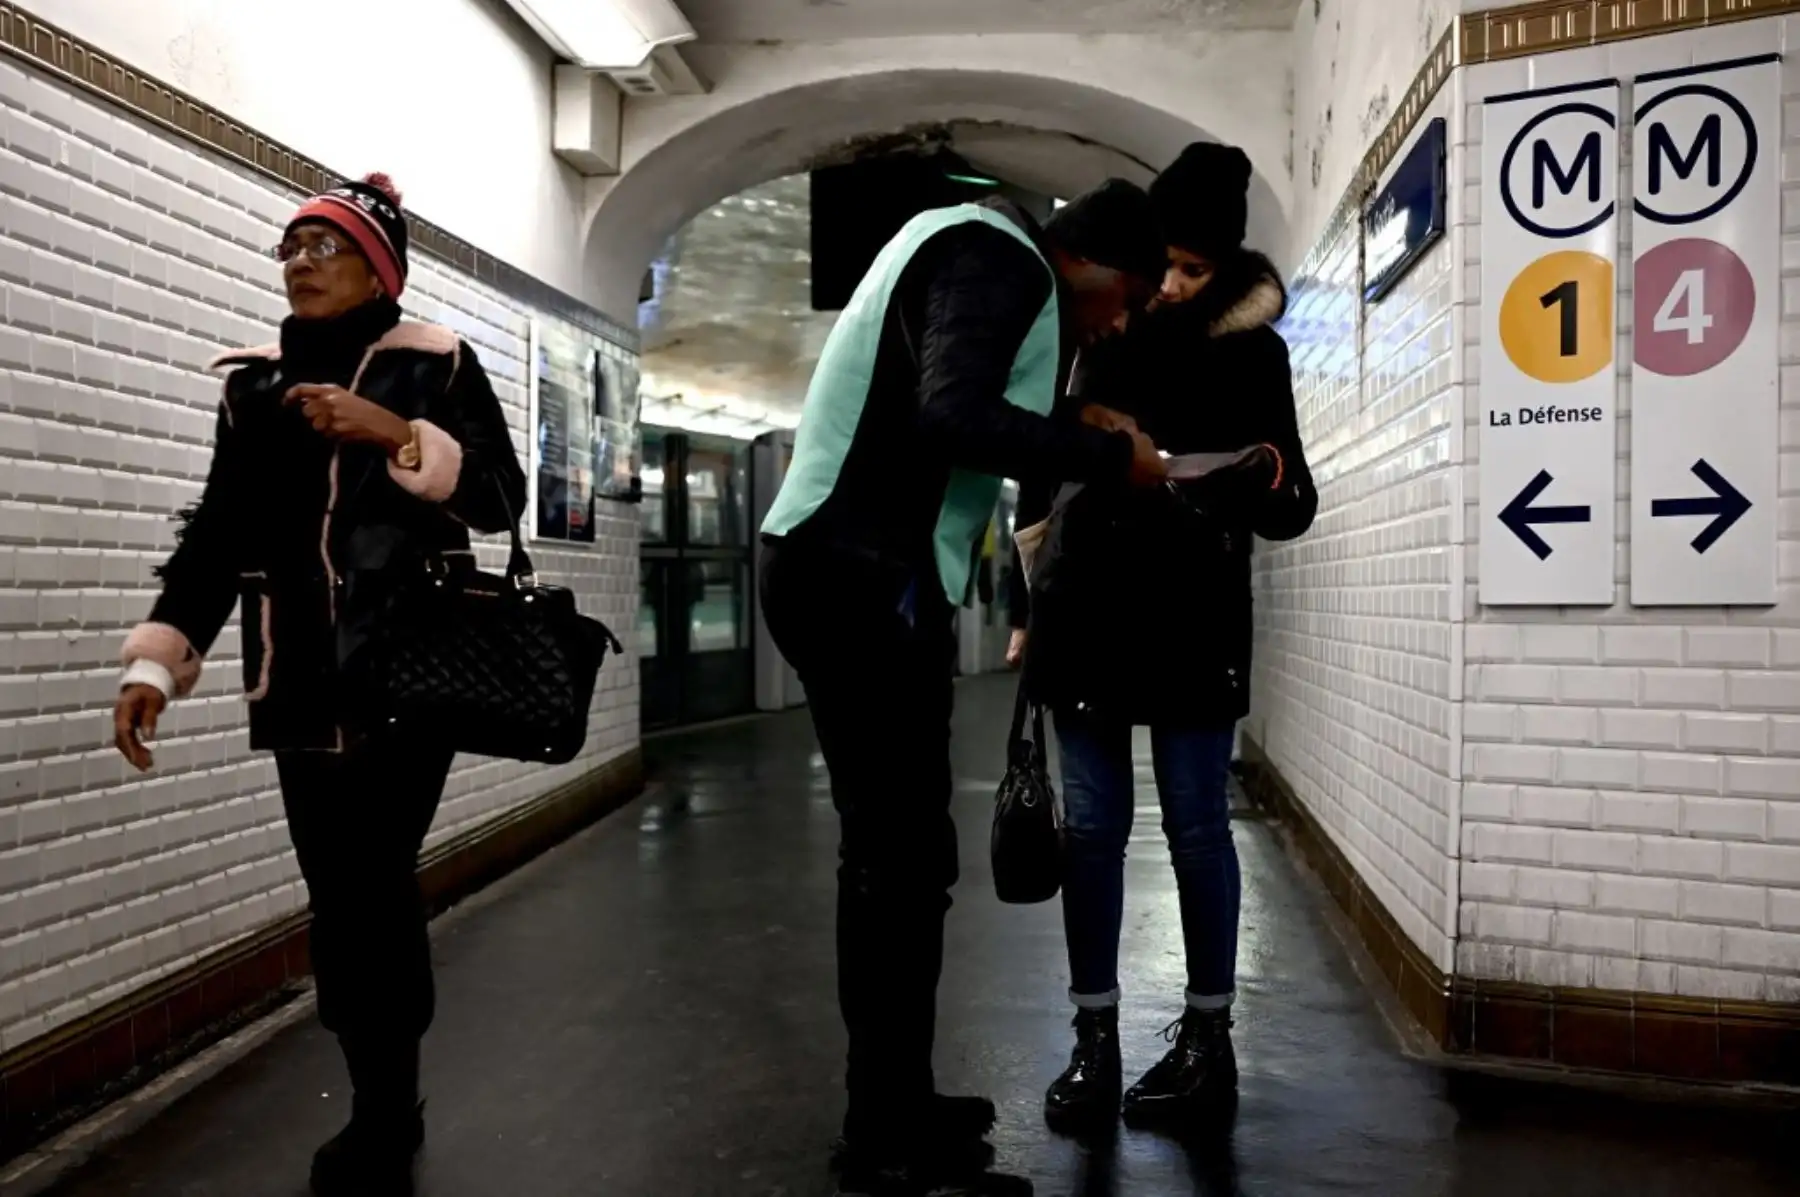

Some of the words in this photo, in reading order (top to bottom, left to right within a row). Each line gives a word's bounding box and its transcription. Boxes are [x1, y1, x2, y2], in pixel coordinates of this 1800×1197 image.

[1532, 131, 1602, 209] M
[1648, 114, 1721, 195] M
[1539, 280, 1579, 357] 1
[1653, 269, 1713, 345] 4
[1489, 410, 1512, 427] La
[1519, 405, 1603, 426] Défense
